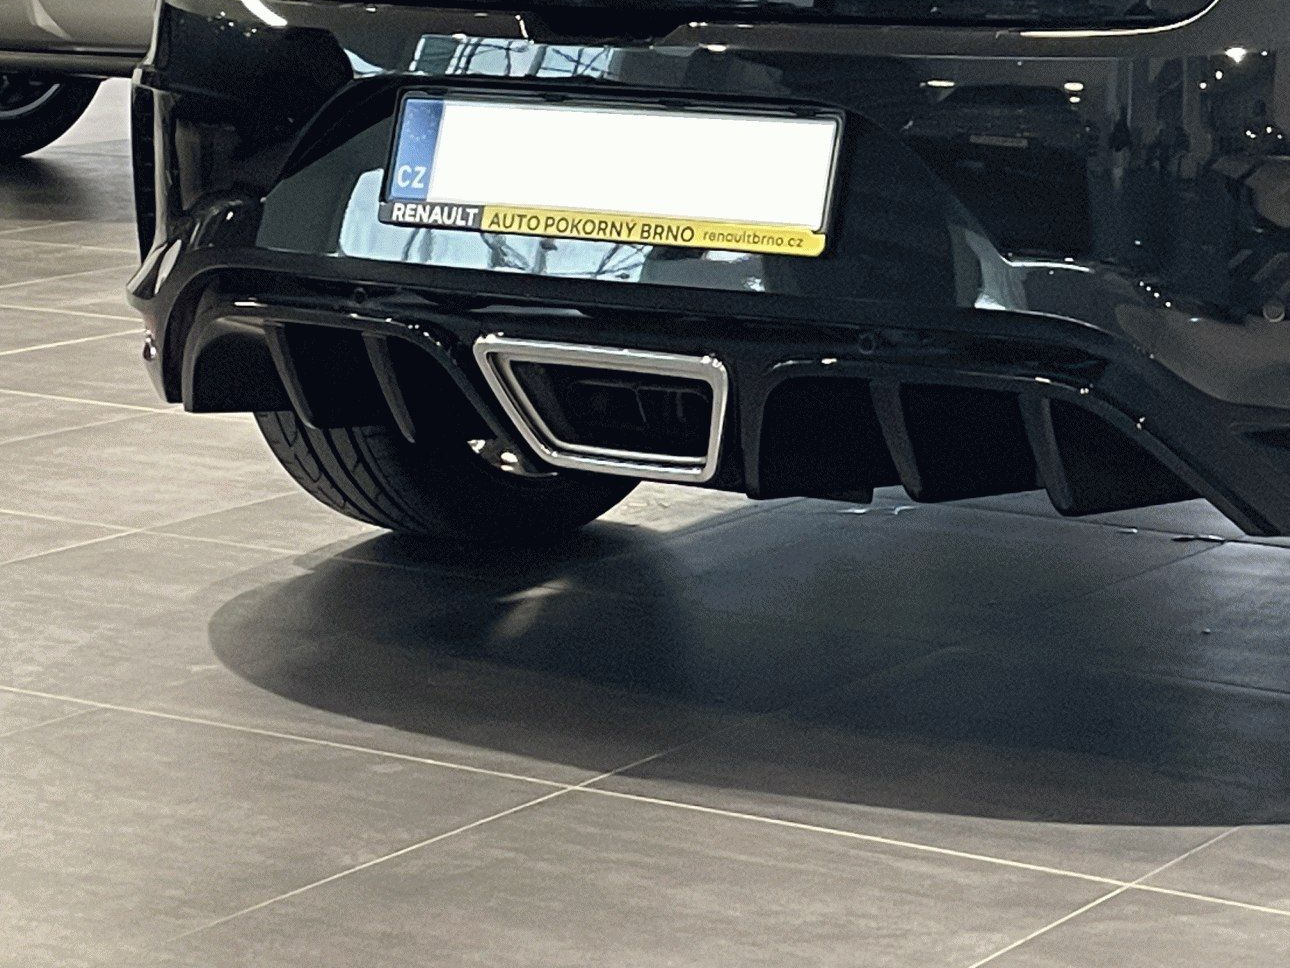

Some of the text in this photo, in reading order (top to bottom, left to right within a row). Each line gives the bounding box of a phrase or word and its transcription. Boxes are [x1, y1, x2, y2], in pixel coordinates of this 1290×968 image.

[397, 165, 427, 189] CZ
[391, 202, 480, 227] RENAULT
[488, 212, 541, 232] AUTO
[544, 216, 637, 241] POKORNÝ
[639, 223, 696, 244] BRNO
